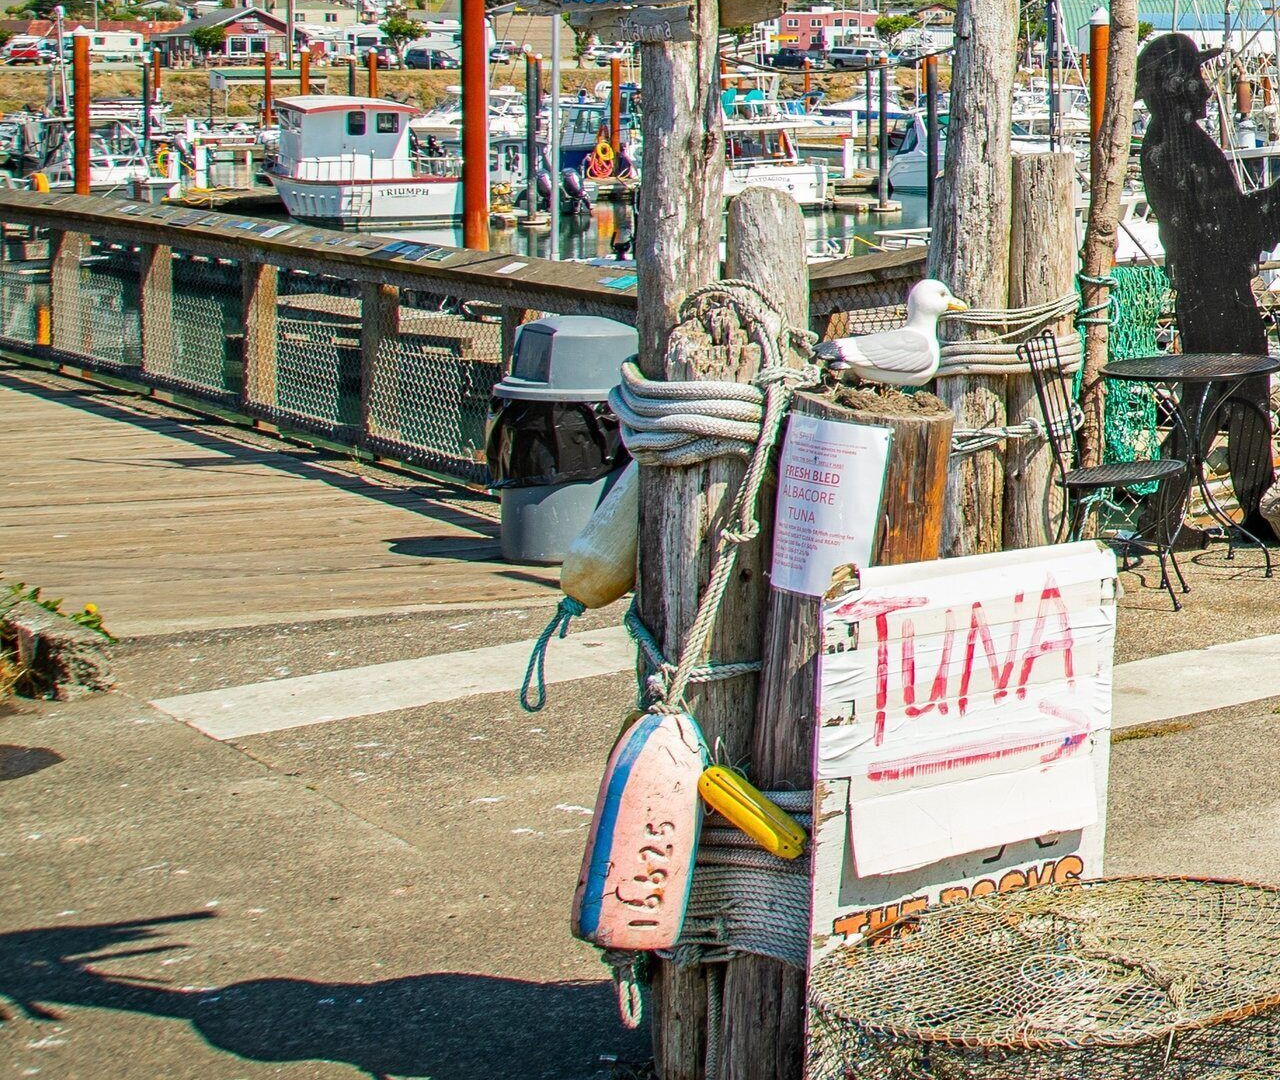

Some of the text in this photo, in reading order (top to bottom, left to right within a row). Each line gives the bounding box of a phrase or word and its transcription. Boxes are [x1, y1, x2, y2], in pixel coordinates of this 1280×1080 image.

[618, 17, 672, 42] Marina
[379, 188, 429, 196] TRIUMPH
[785, 464, 840, 485] FRESH BLED
[782, 483, 836, 506] ALBACORE
[788, 506, 815, 523] TUNA
[836, 572, 1077, 746] TUNA
